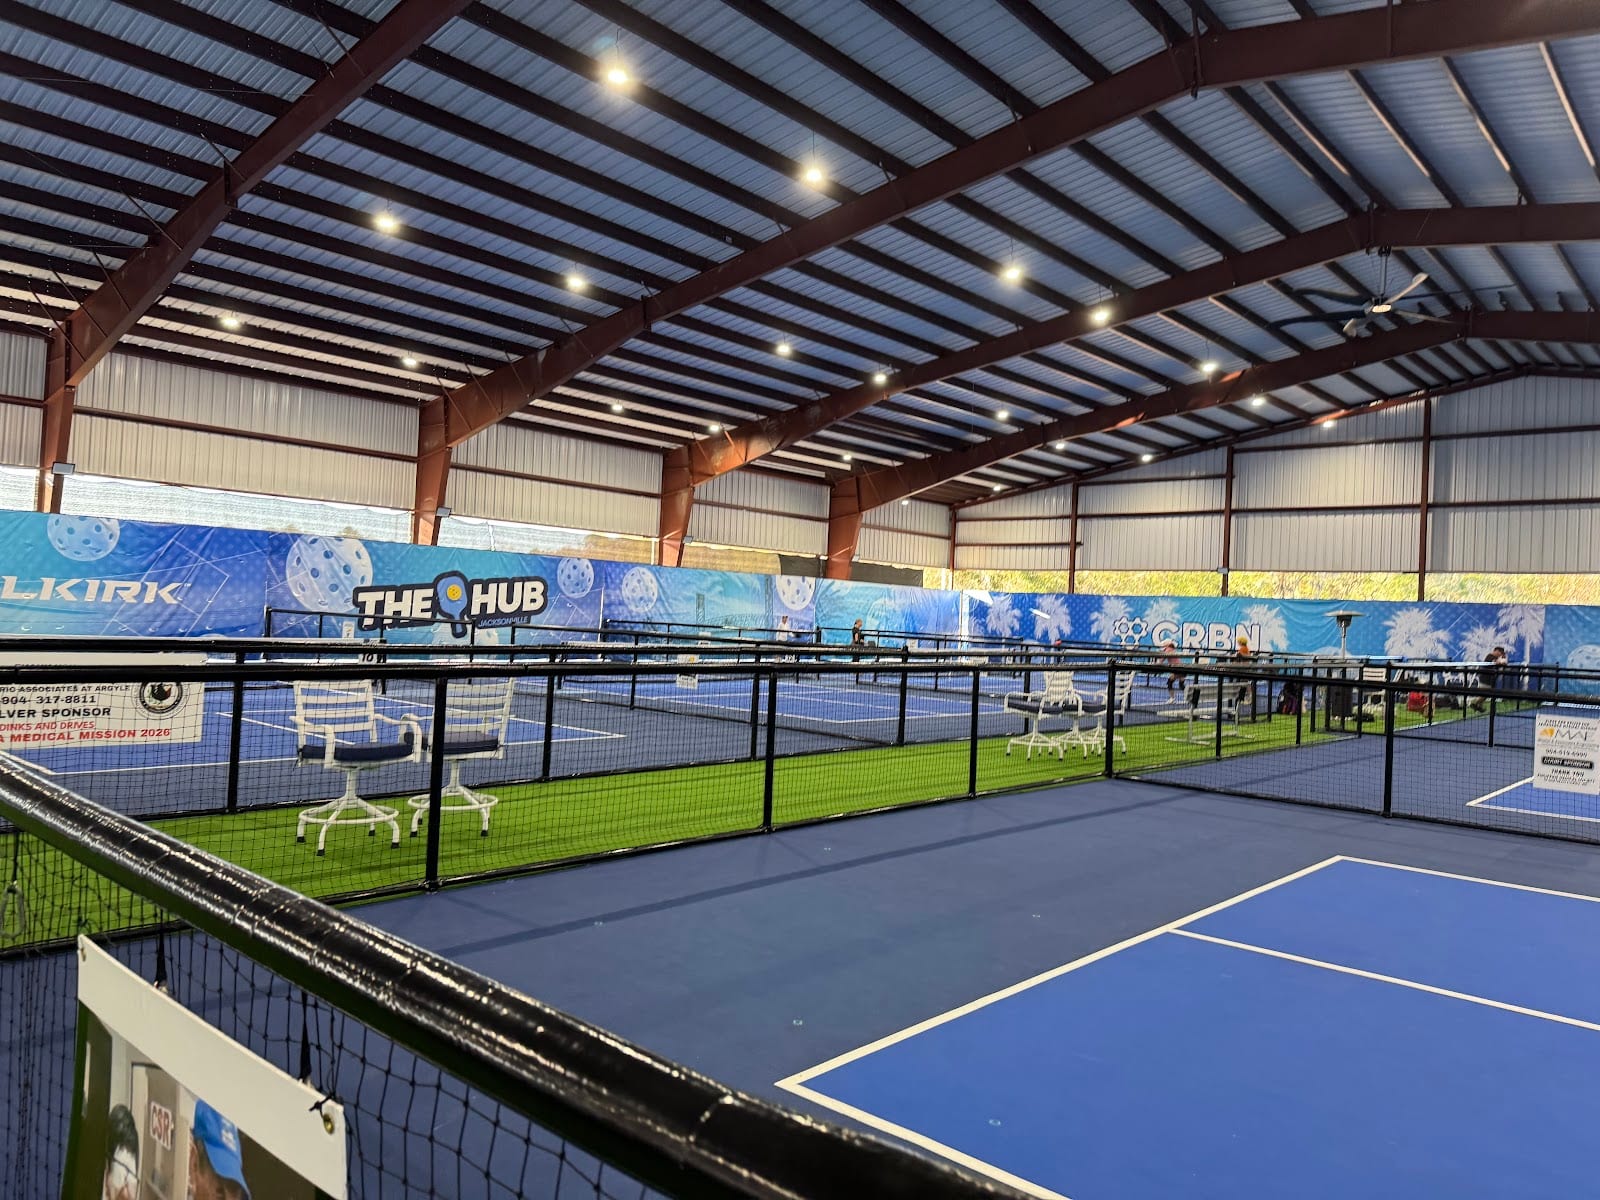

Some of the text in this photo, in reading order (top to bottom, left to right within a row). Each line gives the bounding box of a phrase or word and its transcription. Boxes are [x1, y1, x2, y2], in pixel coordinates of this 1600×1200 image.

[1, 575, 183, 604] LKIRK
[357, 580, 545, 626] THE HUB
[478, 616, 529, 627] JACKSONVILLE
[1152, 620, 1261, 653] CRBN
[36, 695, 97, 704] 317-8811
[42, 707, 112, 718] SPONSOR
[0, 721, 95, 732] DINKS AND DRIVES
[10, 731, 74, 742] MEDICAL
[79, 729, 136, 740] MISSION
[140, 728, 171, 738] 2026
[151, 1104, 170, 1147] CSR
